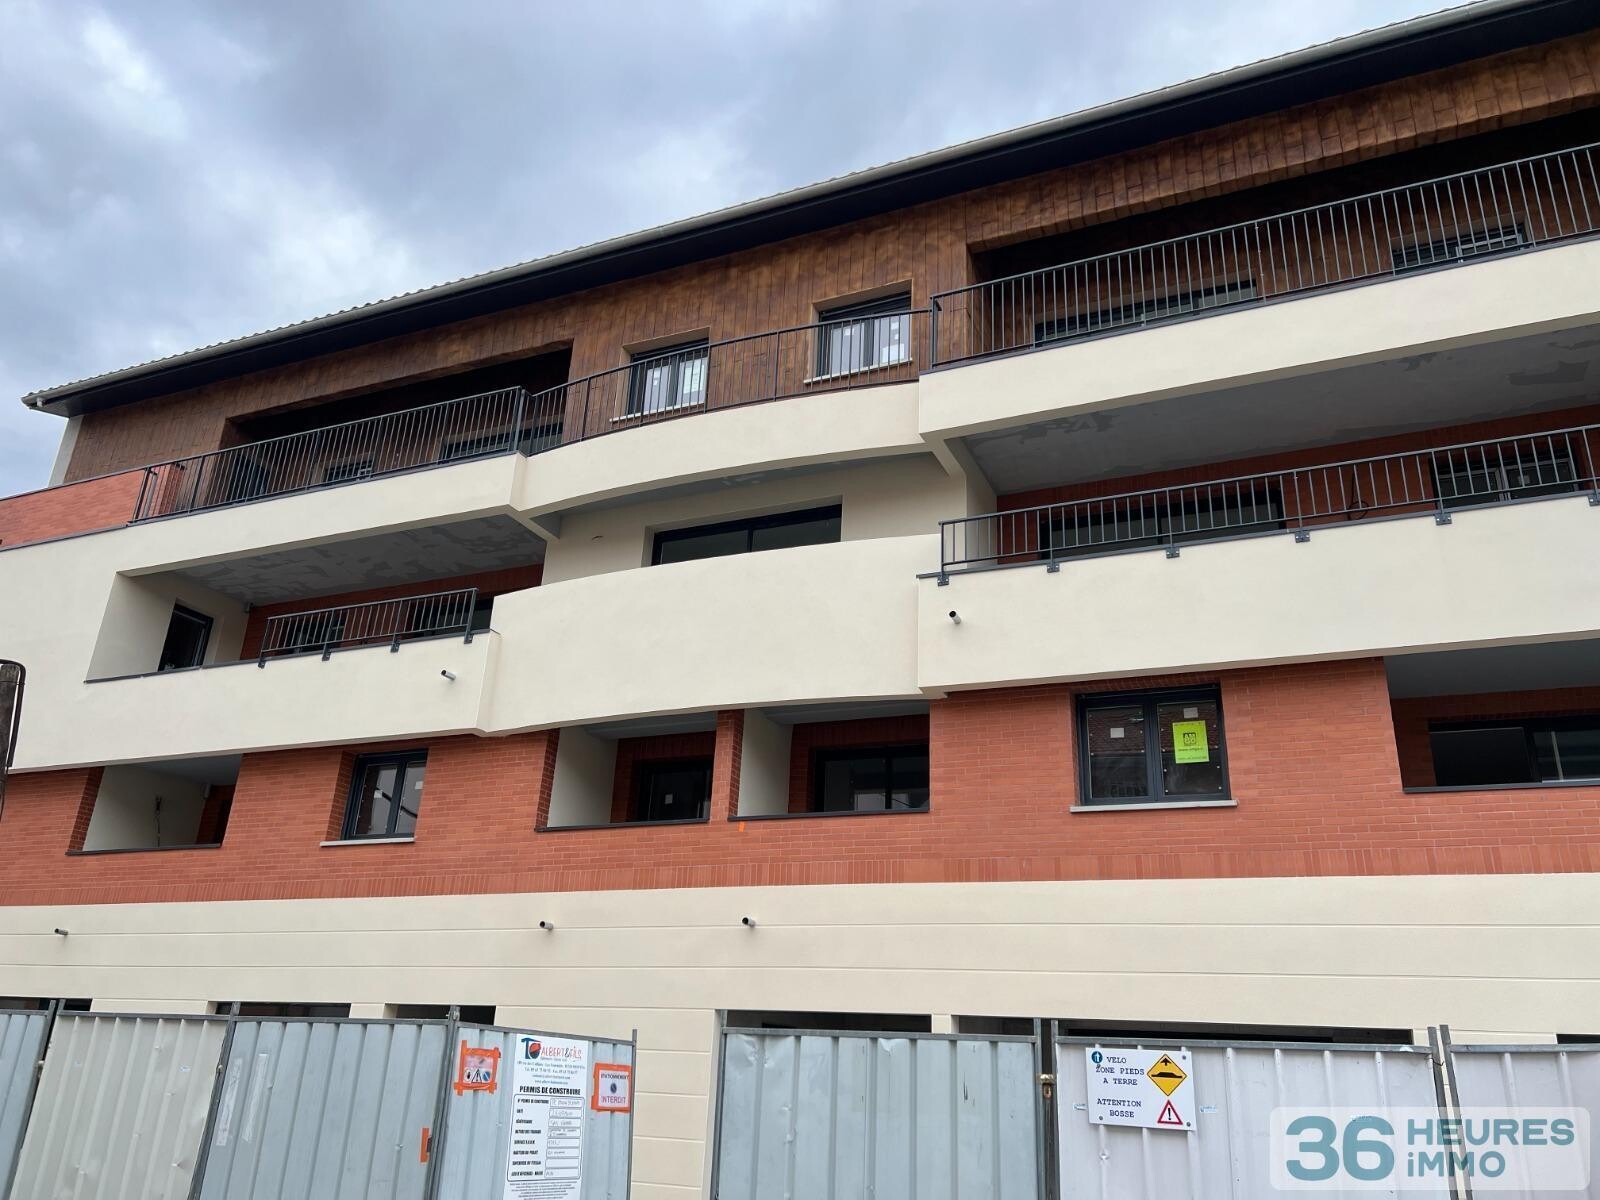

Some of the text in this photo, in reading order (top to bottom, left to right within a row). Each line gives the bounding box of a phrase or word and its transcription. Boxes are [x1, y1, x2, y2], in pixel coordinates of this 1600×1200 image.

[1106, 1056, 1127, 1064] VELO
[1095, 1066, 1145, 1076] ZONE PIEDS
[1112, 1078, 1138, 1086] TERRE
[519, 1086, 541, 1094] PERMIS
[549, 1087, 581, 1096] CONSTRUIRE
[600, 1096, 626, 1104] INTERDIT
[1096, 1098, 1142, 1107] ATTENTION
[1109, 1110, 1135, 1118] BOSSE
